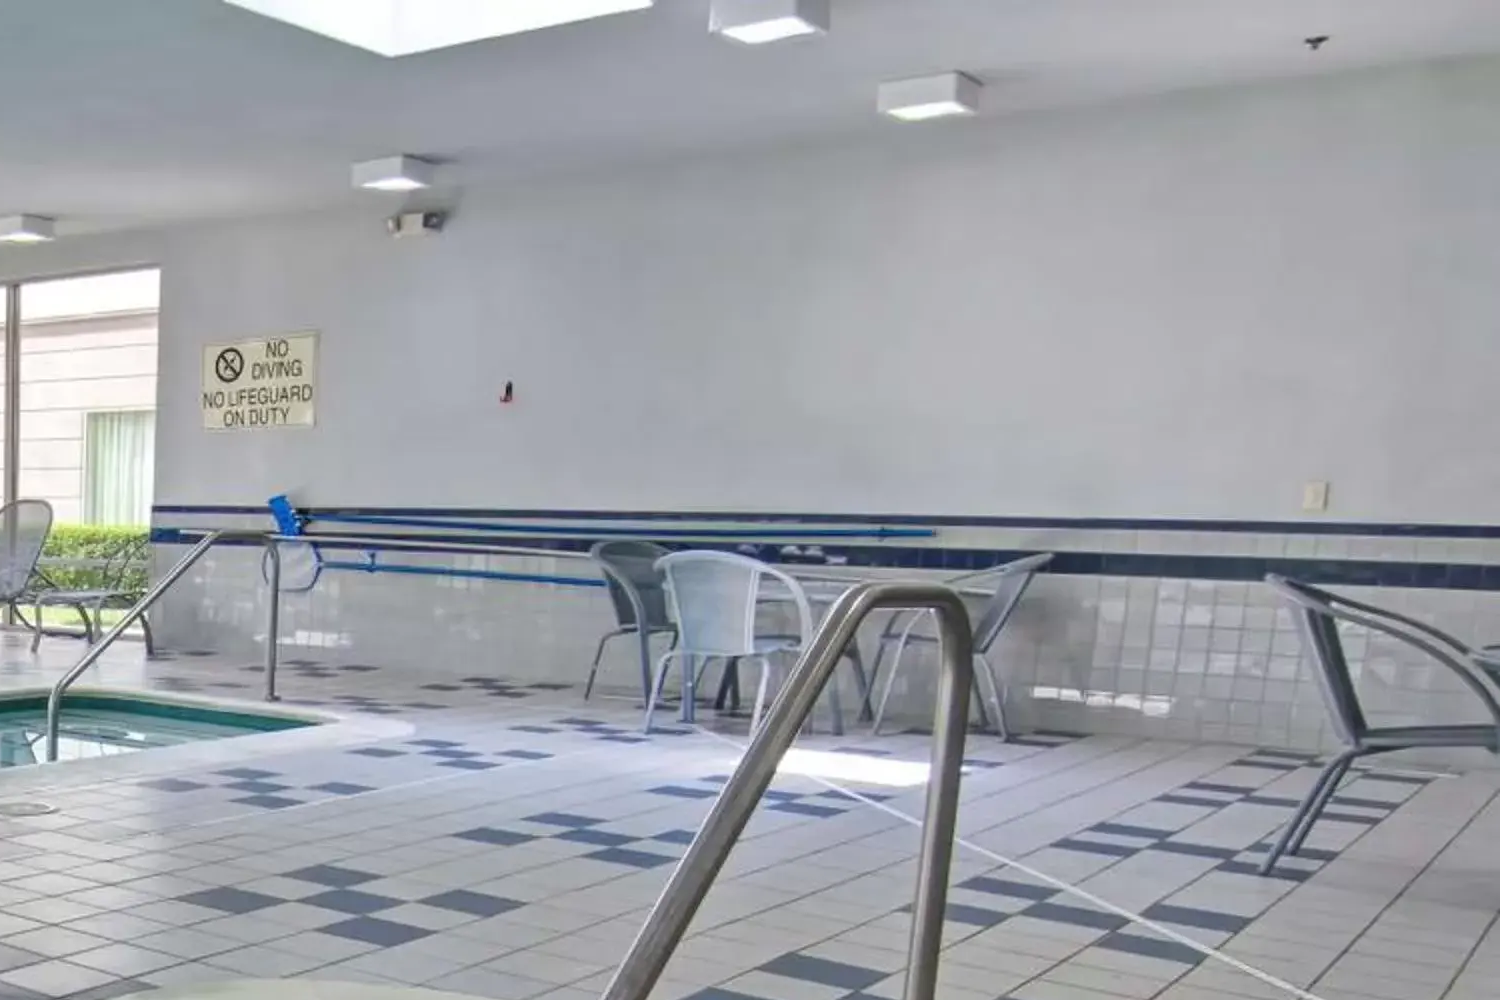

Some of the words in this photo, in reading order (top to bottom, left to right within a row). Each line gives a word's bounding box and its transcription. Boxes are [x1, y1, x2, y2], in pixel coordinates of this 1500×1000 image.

[265, 340, 289, 358] NO
[251, 359, 303, 380] DIVING
[203, 391, 225, 409] NO
[228, 384, 313, 407] LIFEGUARD
[223, 410, 245, 427] ON
[249, 407, 290, 425] DUTY
